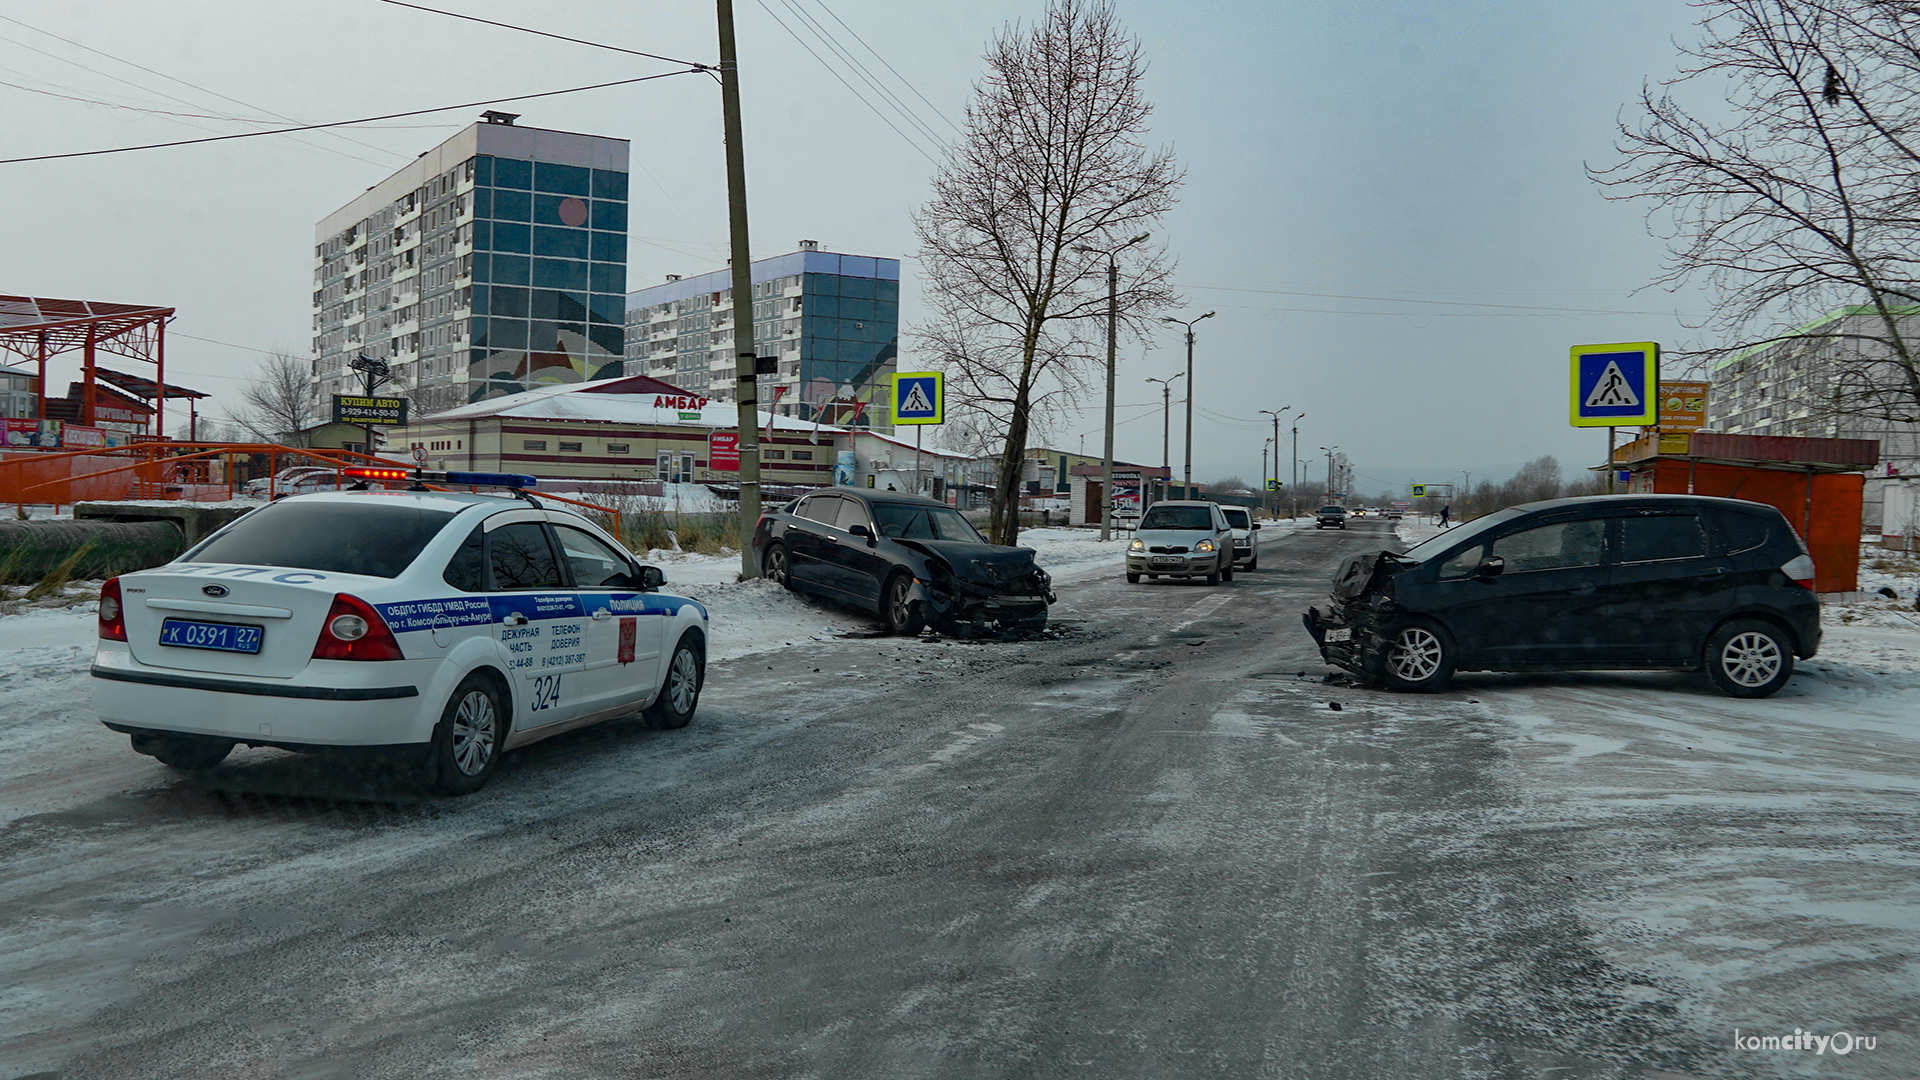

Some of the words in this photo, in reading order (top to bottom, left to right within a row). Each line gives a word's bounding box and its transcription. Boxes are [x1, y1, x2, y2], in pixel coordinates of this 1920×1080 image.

[340, 397, 374, 407] КУПИМ
[375, 399, 400, 408] АВТО
[653, 395, 707, 410] АМБАР
[340, 407, 400, 417] 8-929-414-50-50
[387, 604, 417, 617] ОБДПС
[418, 602, 443, 614] ГИБДД
[443, 600, 466, 612] УМВД
[465, 600, 489, 609] России
[609, 600, 645, 612] ПОЛИЦИЯ
[389, 620, 400, 629] по
[401, 620, 407, 628] г.
[408, 613, 491, 627] Комсомольску-на-Амуре
[169, 627, 180, 642] К
[186, 625, 228, 646] 0391
[236, 628, 255, 643] 27
[501, 627, 540, 642] ДЕЖУРНАЯ
[551, 624, 580, 636] ТЕЛЕФОН
[237, 642, 251, 650] RUS
[509, 642, 533, 653] ЧАСТЬ
[551, 637, 580, 651] ДОВЕРИЯ
[541, 657, 546, 667] 8
[546, 655, 564, 668] (4212)
[564, 653, 586, 665] 387-387
[531, 674, 561, 712] 324
